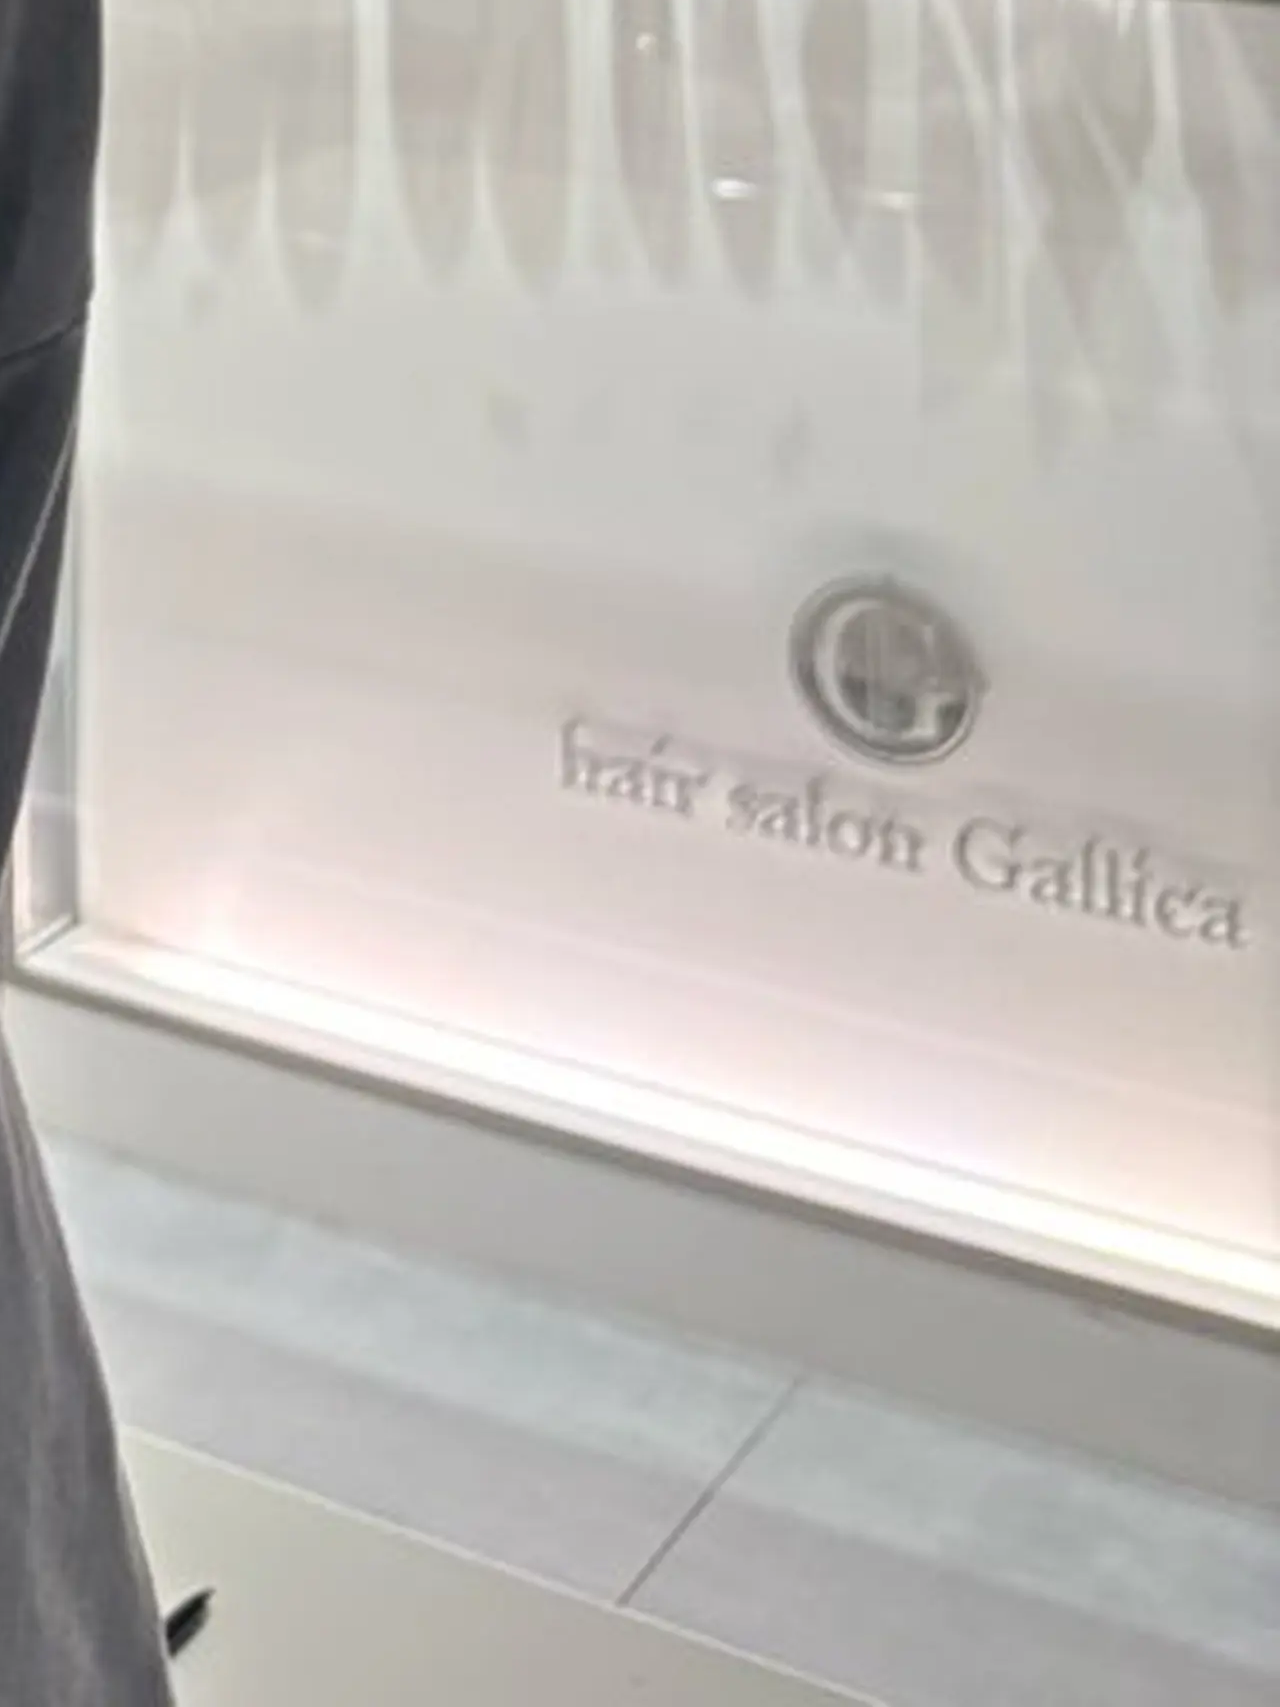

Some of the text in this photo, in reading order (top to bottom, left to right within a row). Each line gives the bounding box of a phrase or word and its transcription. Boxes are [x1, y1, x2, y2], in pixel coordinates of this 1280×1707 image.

[558, 715, 1253, 951] hair salon Gallica
